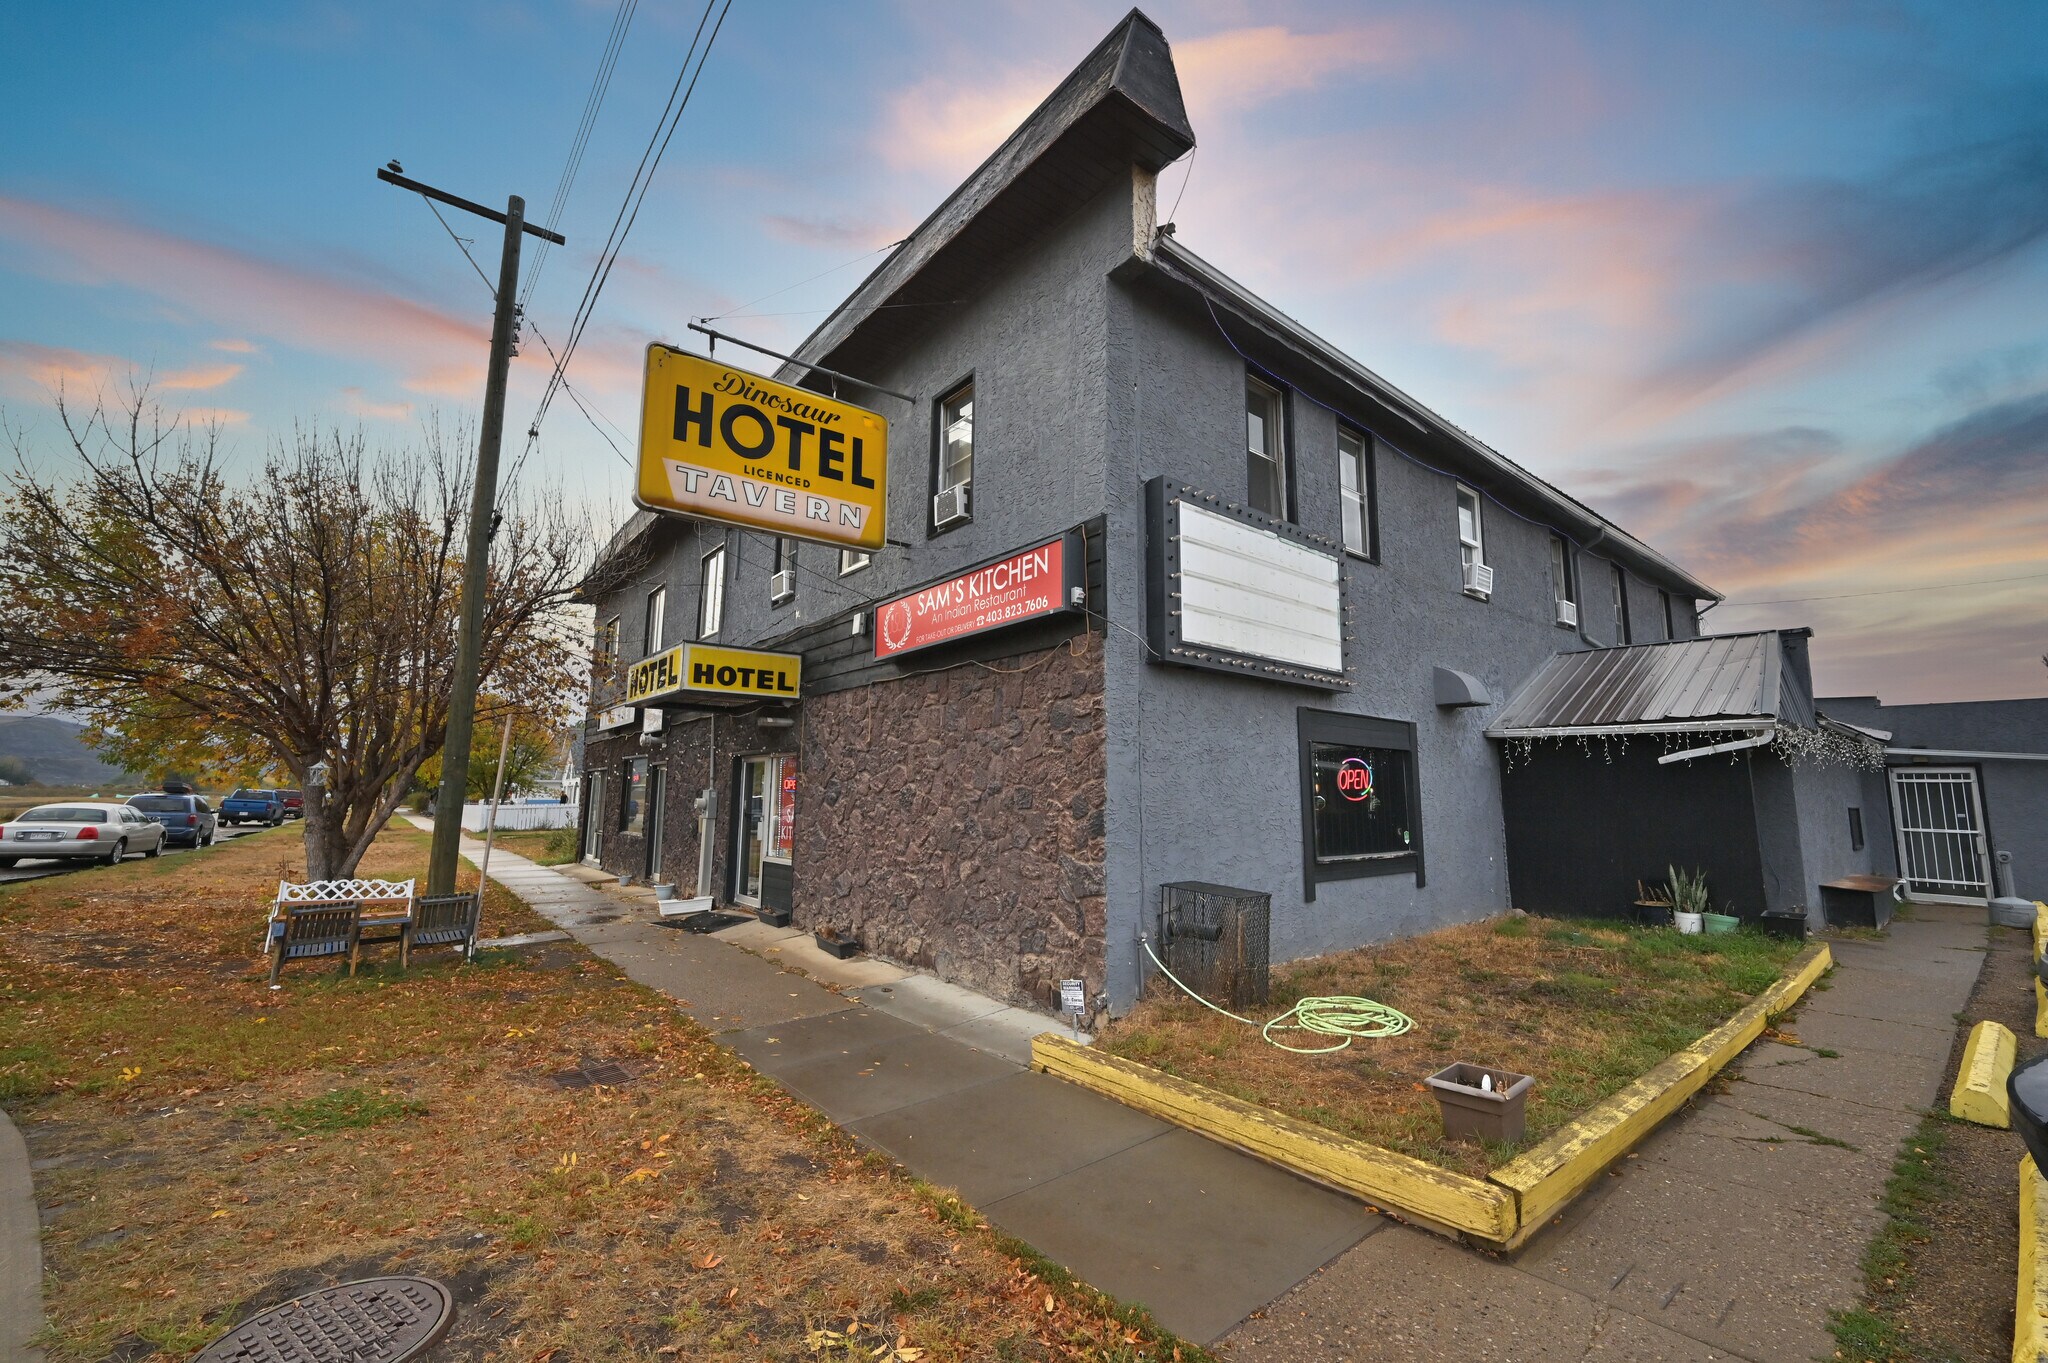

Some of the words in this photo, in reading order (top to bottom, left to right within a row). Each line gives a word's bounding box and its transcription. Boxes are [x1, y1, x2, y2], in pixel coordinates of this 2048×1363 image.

[713, 372, 841, 425] Dinosaur
[673, 384, 875, 490] HOTEL
[675, 465, 862, 529] TAVERN
[743, 464, 811, 488] LICENCED
[917, 579, 964, 616] SAM'S
[969, 548, 1049, 599] KITCHEN
[925, 628, 947, 641] TAKE-OUT
[947, 626, 955, 637] OR
[955, 619, 976, 635] DELIVERY
[985, 595, 1049, 624] 403.823.7606
[931, 612, 943, 625] An
[944, 602, 972, 620] Indian
[974, 584, 1027, 612] Restaurant
[630, 654, 678, 698] HOTEL
[693, 662, 795, 692] HOTEL
[1339, 769, 1369, 790] OPEN
[781, 825, 793, 840] KIT
